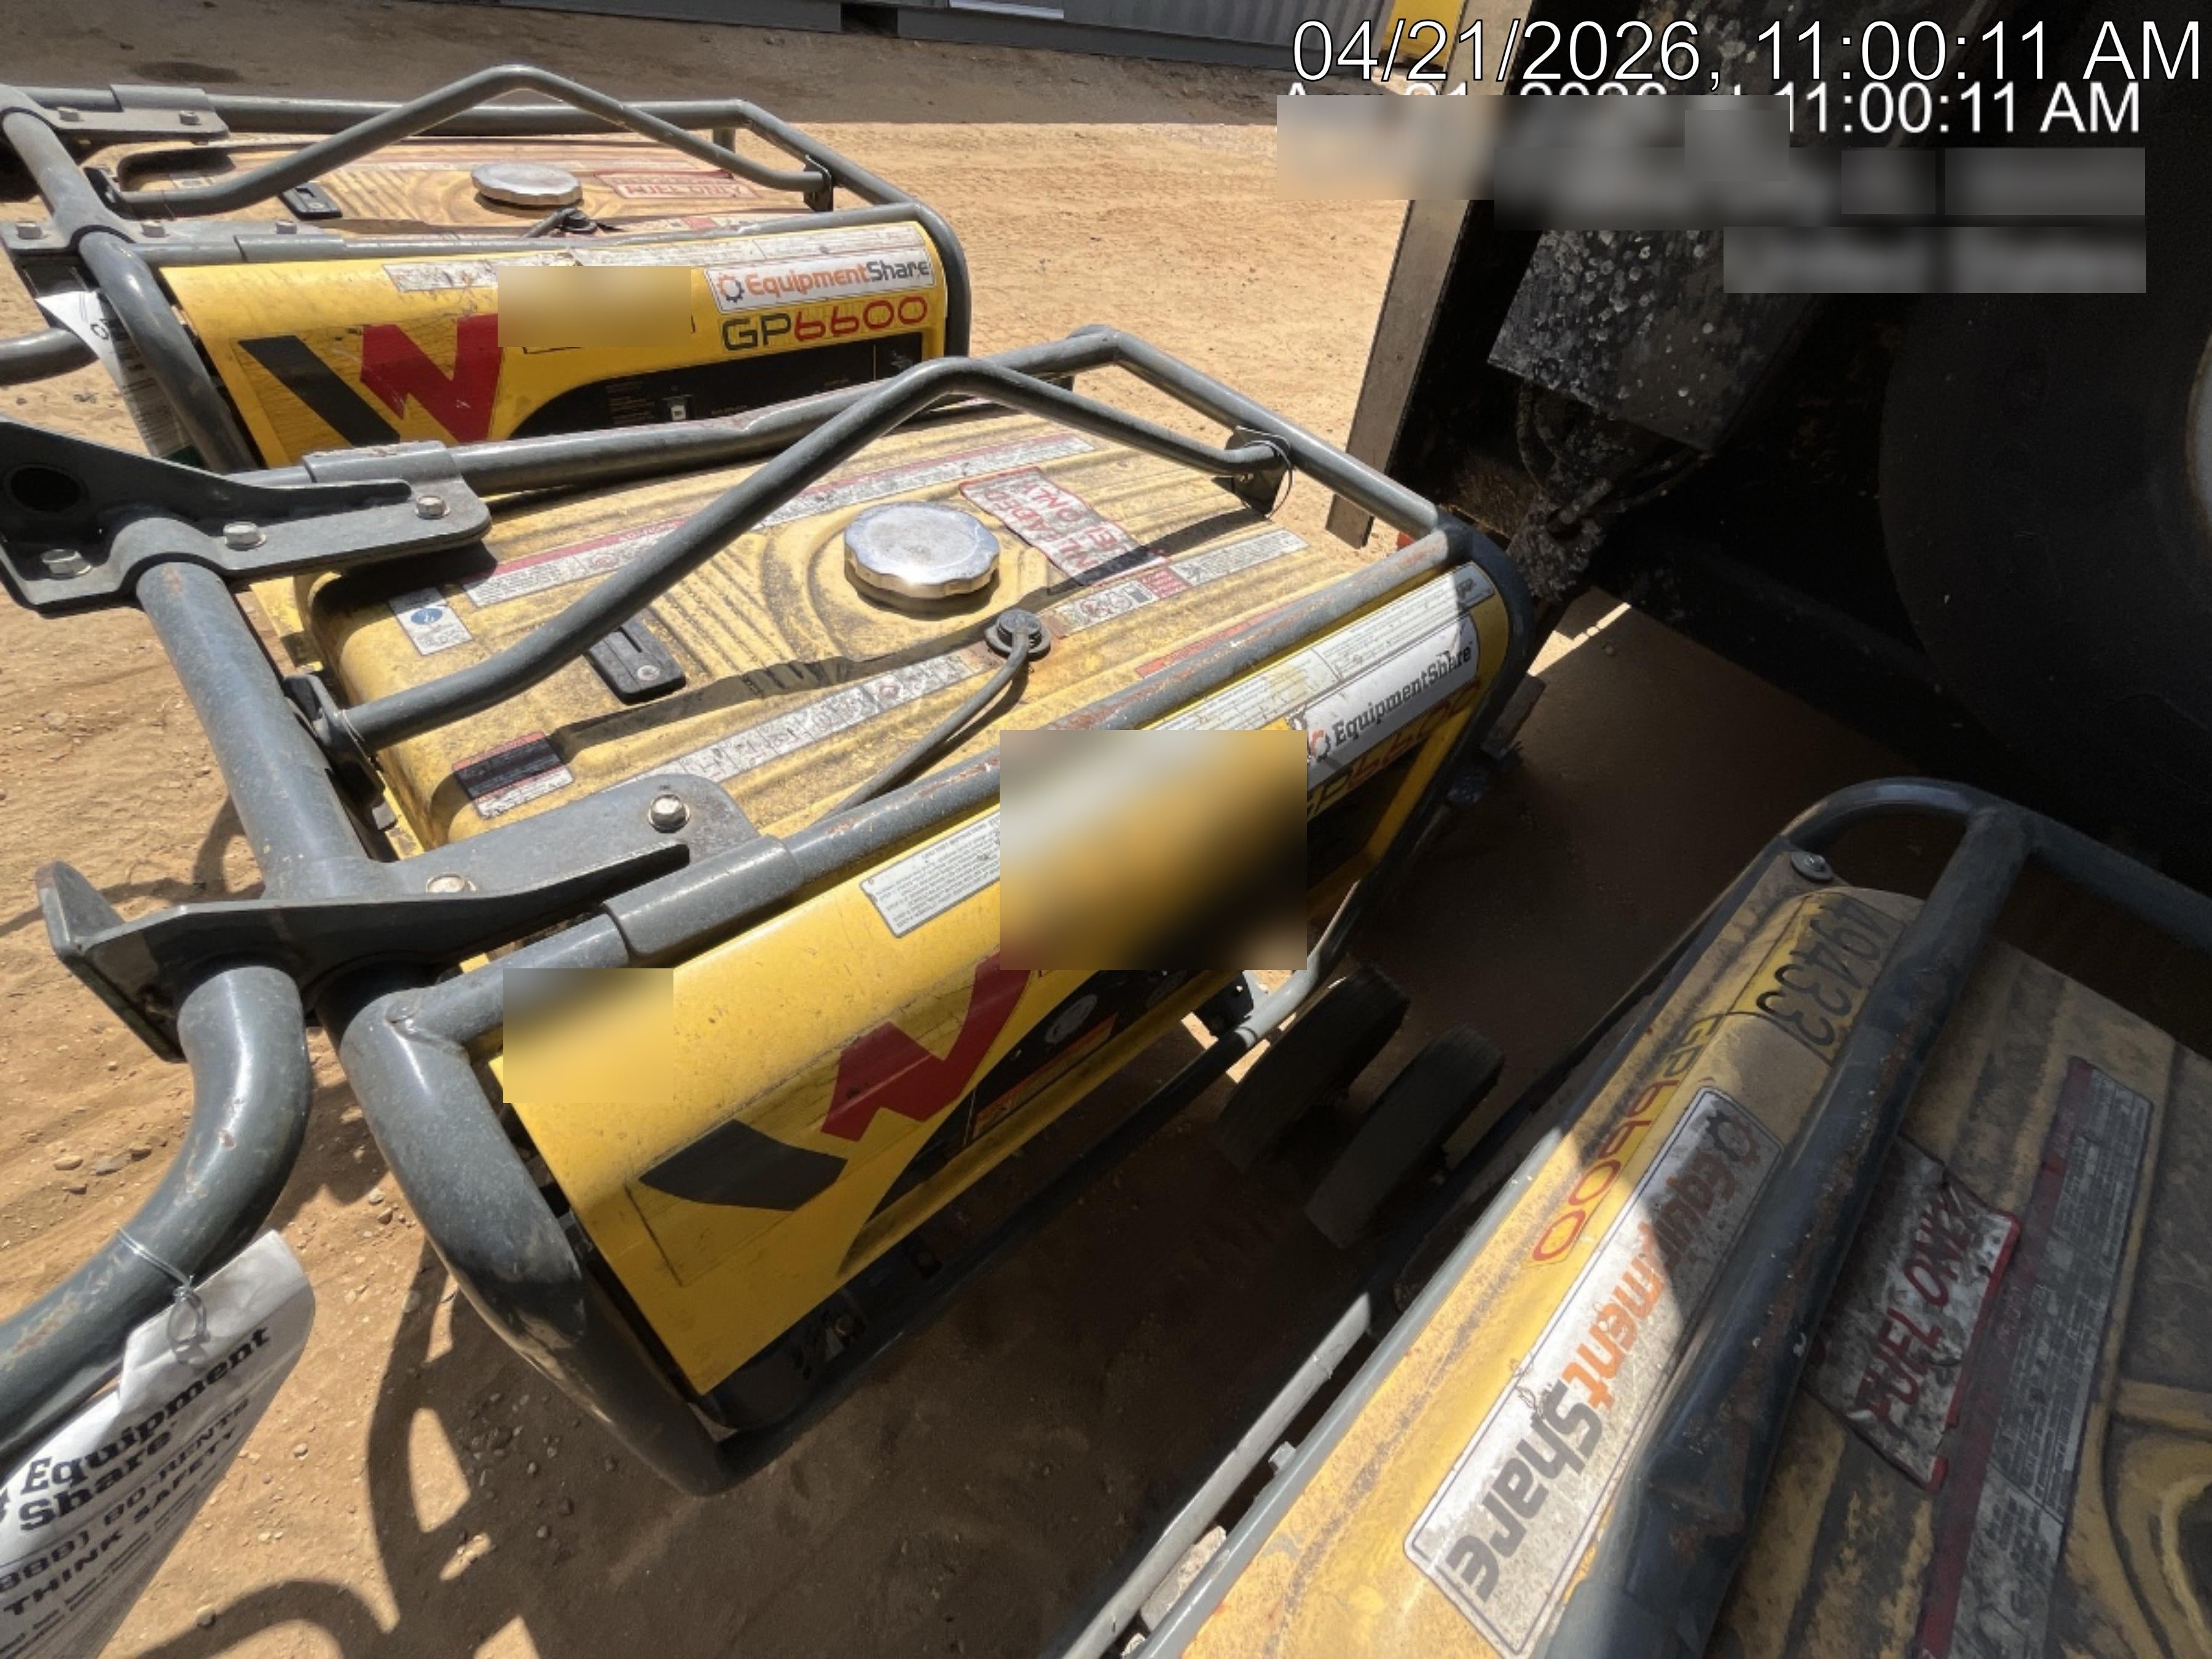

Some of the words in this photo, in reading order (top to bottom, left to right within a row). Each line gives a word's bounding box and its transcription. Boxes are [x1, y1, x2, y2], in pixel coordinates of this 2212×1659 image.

[721, 296, 928, 351] GP6600
[744, 259, 930, 298] EquipmentShare
[1332, 646, 1472, 747] EquipmentShare
[1756, 901, 1890, 1056] 49433
[1531, 1014, 1725, 1261] GP6600
[20, 1327, 270, 1494] Equipment
[1445, 1150, 1740, 1602] EquipmentShare
[1856, 1306, 1943, 1419] FUEL
[4, 1528, 124, 1616] THINK
[133, 1426, 237, 1523] SAFETY
[19, 1431, 171, 1531] Share
